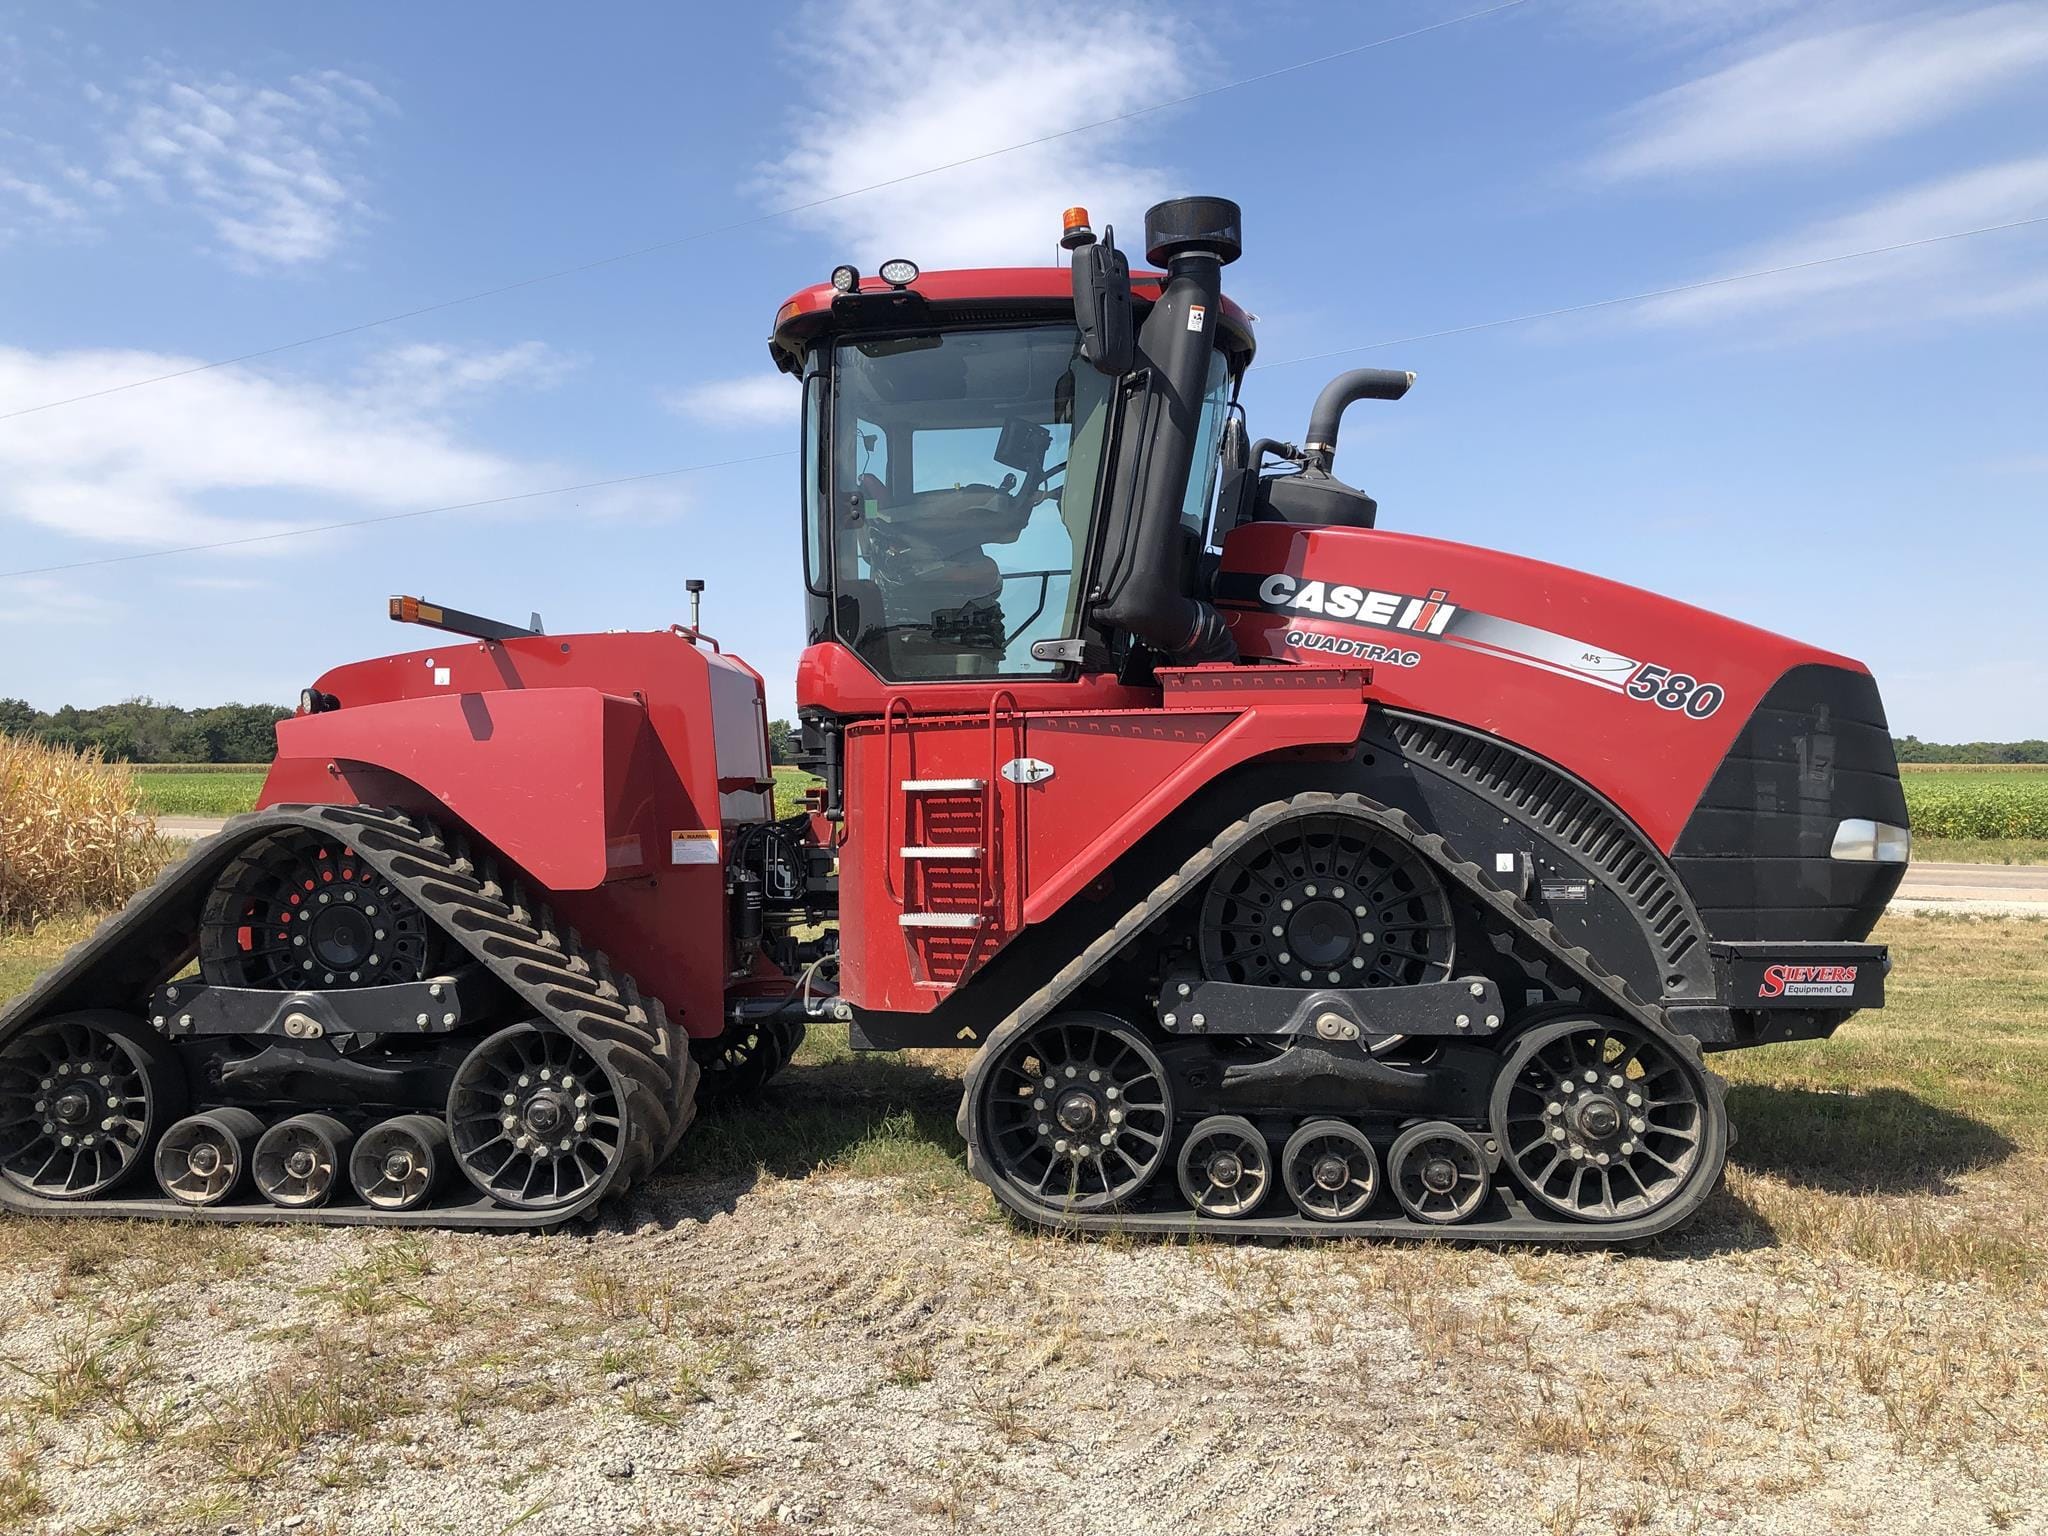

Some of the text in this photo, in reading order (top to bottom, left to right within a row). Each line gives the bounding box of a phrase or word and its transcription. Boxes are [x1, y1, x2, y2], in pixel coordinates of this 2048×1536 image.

[1260, 574, 1402, 625] CASE
[1285, 630, 1420, 667] QUADTRAC
[1581, 652, 1601, 664] AFS
[1627, 662, 1724, 719] 580
[1758, 964, 1858, 997] SIEVERS
[1788, 985, 1849, 994] Equipment Co.
